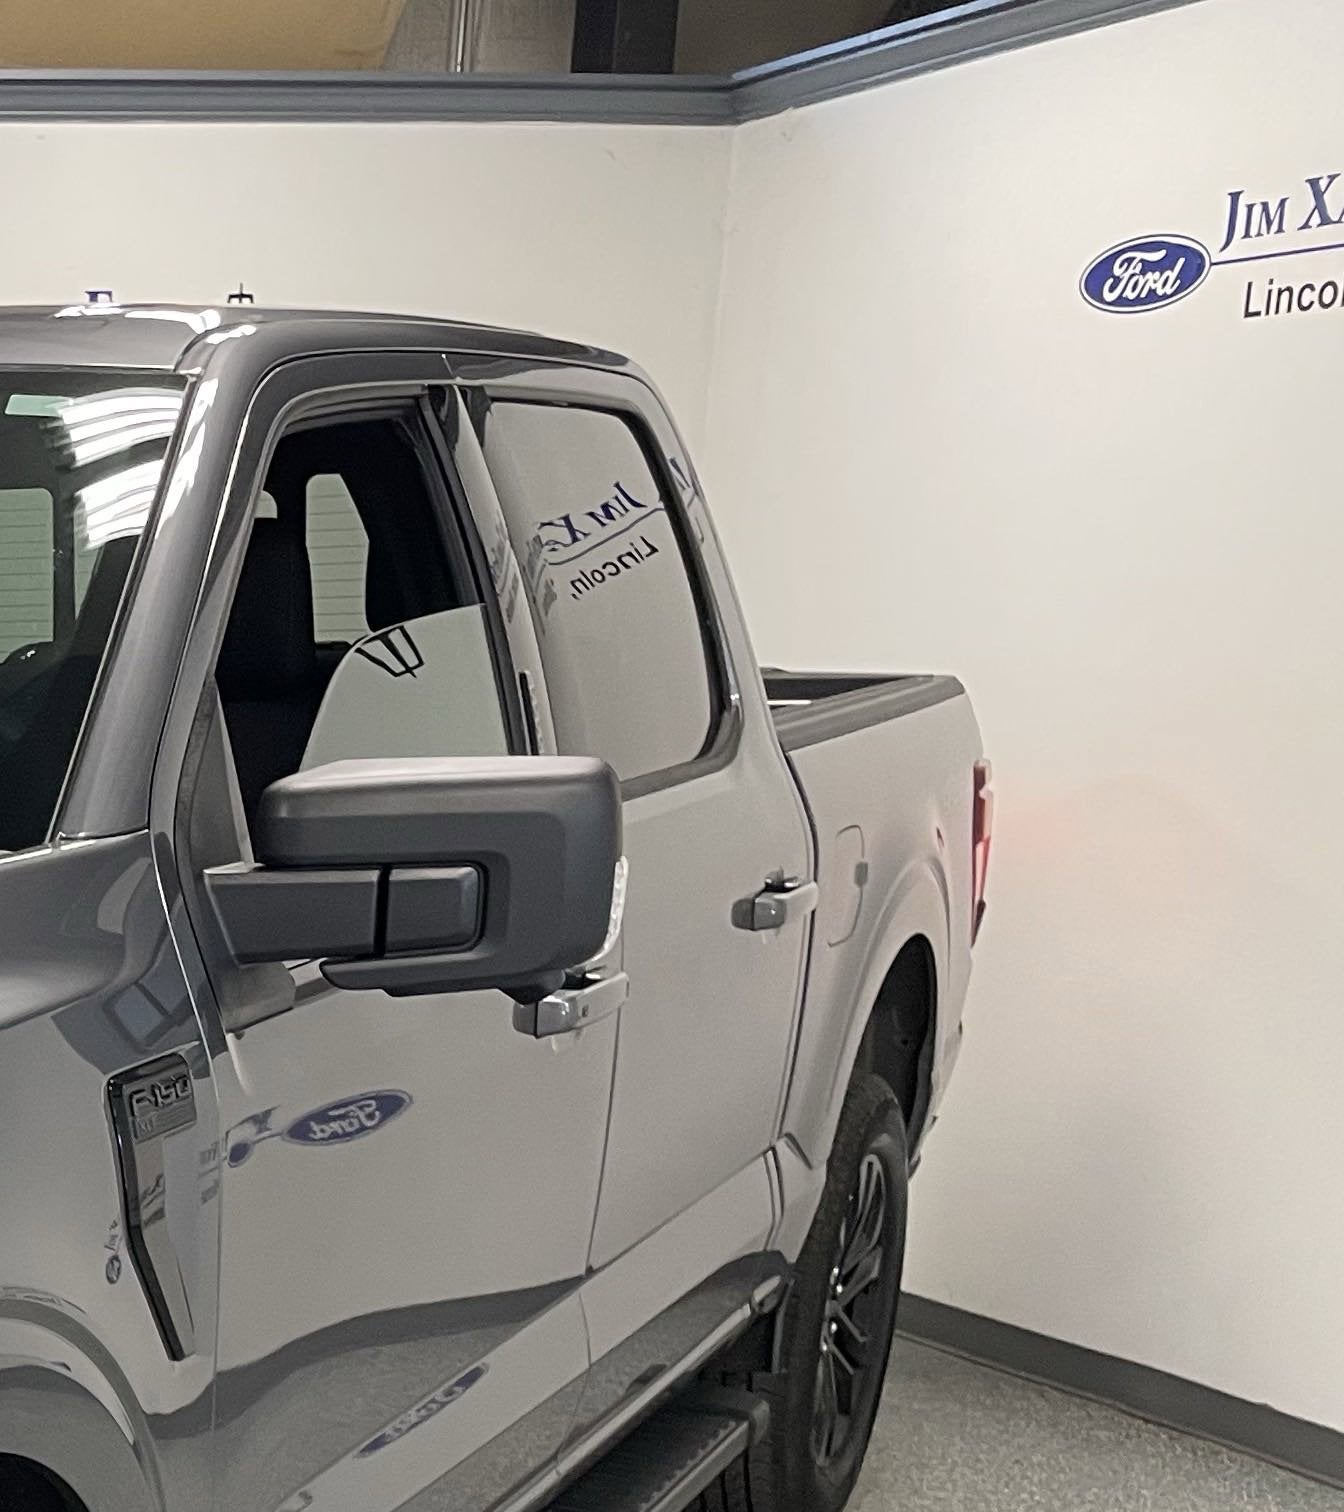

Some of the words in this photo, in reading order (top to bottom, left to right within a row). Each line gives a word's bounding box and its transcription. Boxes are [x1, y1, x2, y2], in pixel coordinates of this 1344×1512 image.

[1219, 190, 1290, 252] JIM
[1103, 249, 1186, 302] Ford
[1243, 278, 1344, 318] Linco
